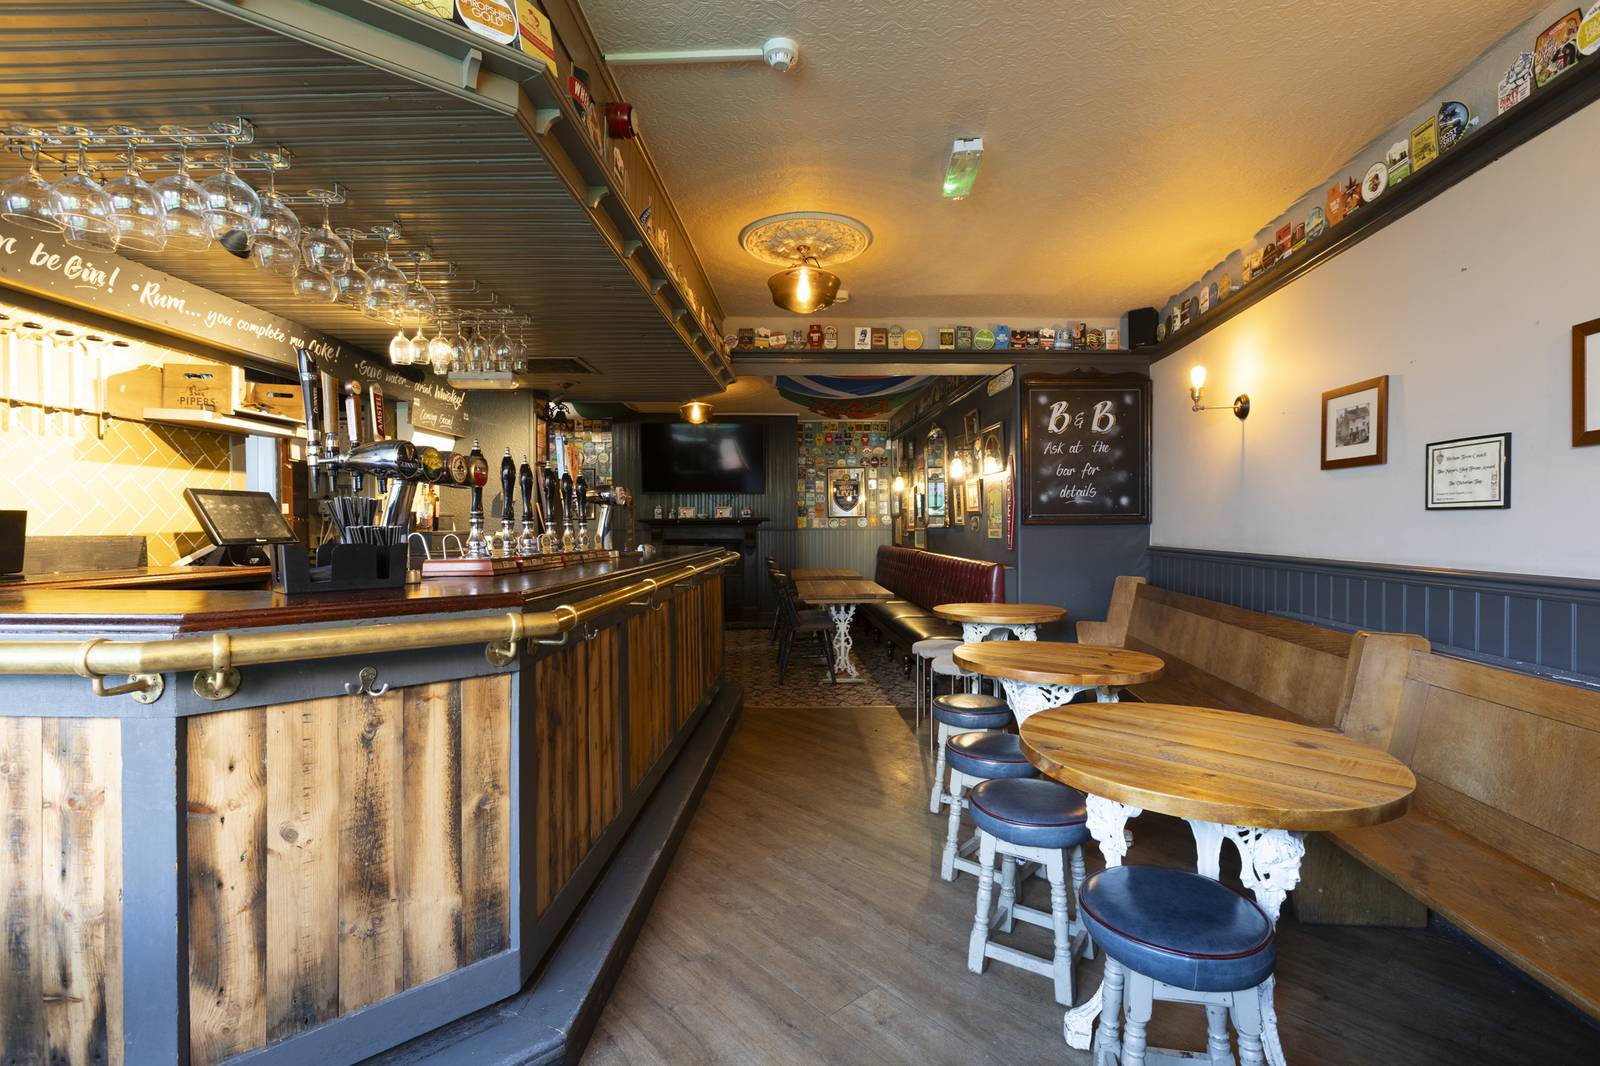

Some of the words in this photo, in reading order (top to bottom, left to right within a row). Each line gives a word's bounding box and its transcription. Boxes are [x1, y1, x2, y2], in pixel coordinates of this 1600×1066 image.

[471, 7, 504, 27] GOLD
[30, 242, 63, 271] be
[64, 255, 121, 293] Gin!
[204, 310, 233, 328] you
[237, 319, 286, 343] complete
[359, 360, 383, 379] Save
[414, 382, 433, 397] drink
[374, 394, 384, 432] AMSTEL
[1047, 400, 1072, 434] B
[1074, 411, 1085, 429] &
[1091, 400, 1116, 433] B
[1043, 441, 1065, 455] Ask
[1069, 440, 1082, 454] at
[1091, 440, 1111, 454] the
[1056, 463, 1076, 477] bar
[1081, 462, 1100, 479] for
[1059, 482, 1097, 499] details
